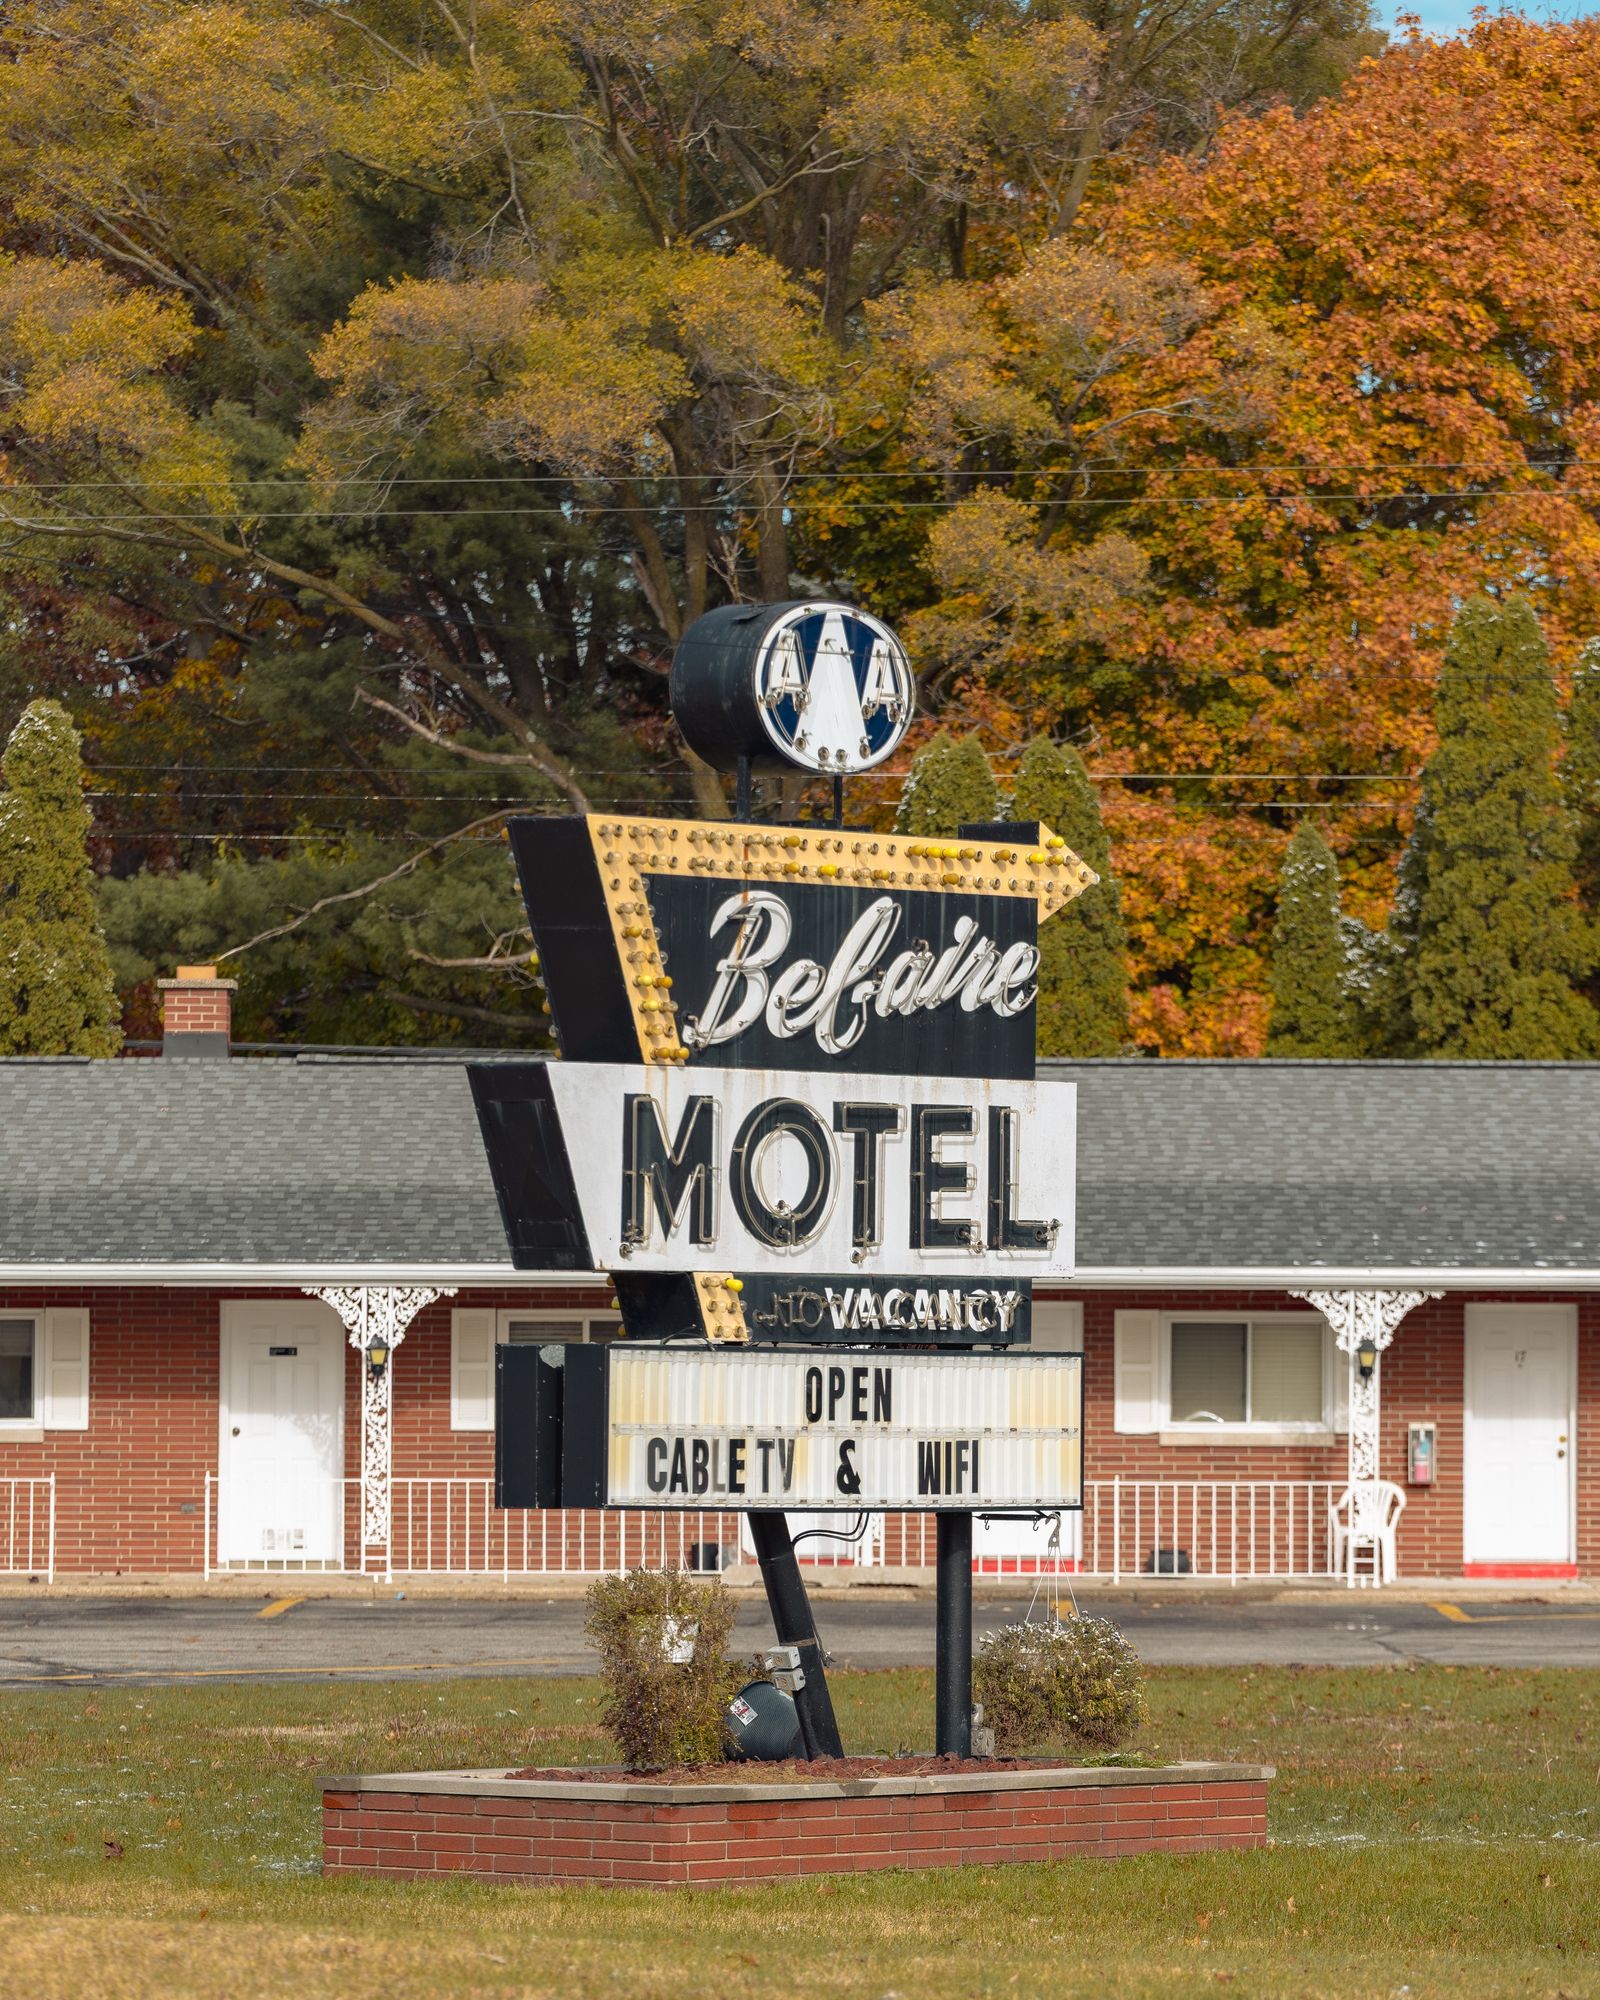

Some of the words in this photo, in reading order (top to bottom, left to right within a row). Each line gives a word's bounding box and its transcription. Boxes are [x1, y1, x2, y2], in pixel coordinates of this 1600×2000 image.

[620, 1093, 1062, 1258] MOTEL
[772, 1290, 825, 1328] NO
[824, 1287, 1024, 1333] VACANCY
[804, 1366, 893, 1423] OPEN
[646, 1437, 747, 1494] CABLE
[756, 1438, 795, 1494] TV
[835, 1438, 862, 1495] &
[917, 1439, 980, 1495] WIFI
